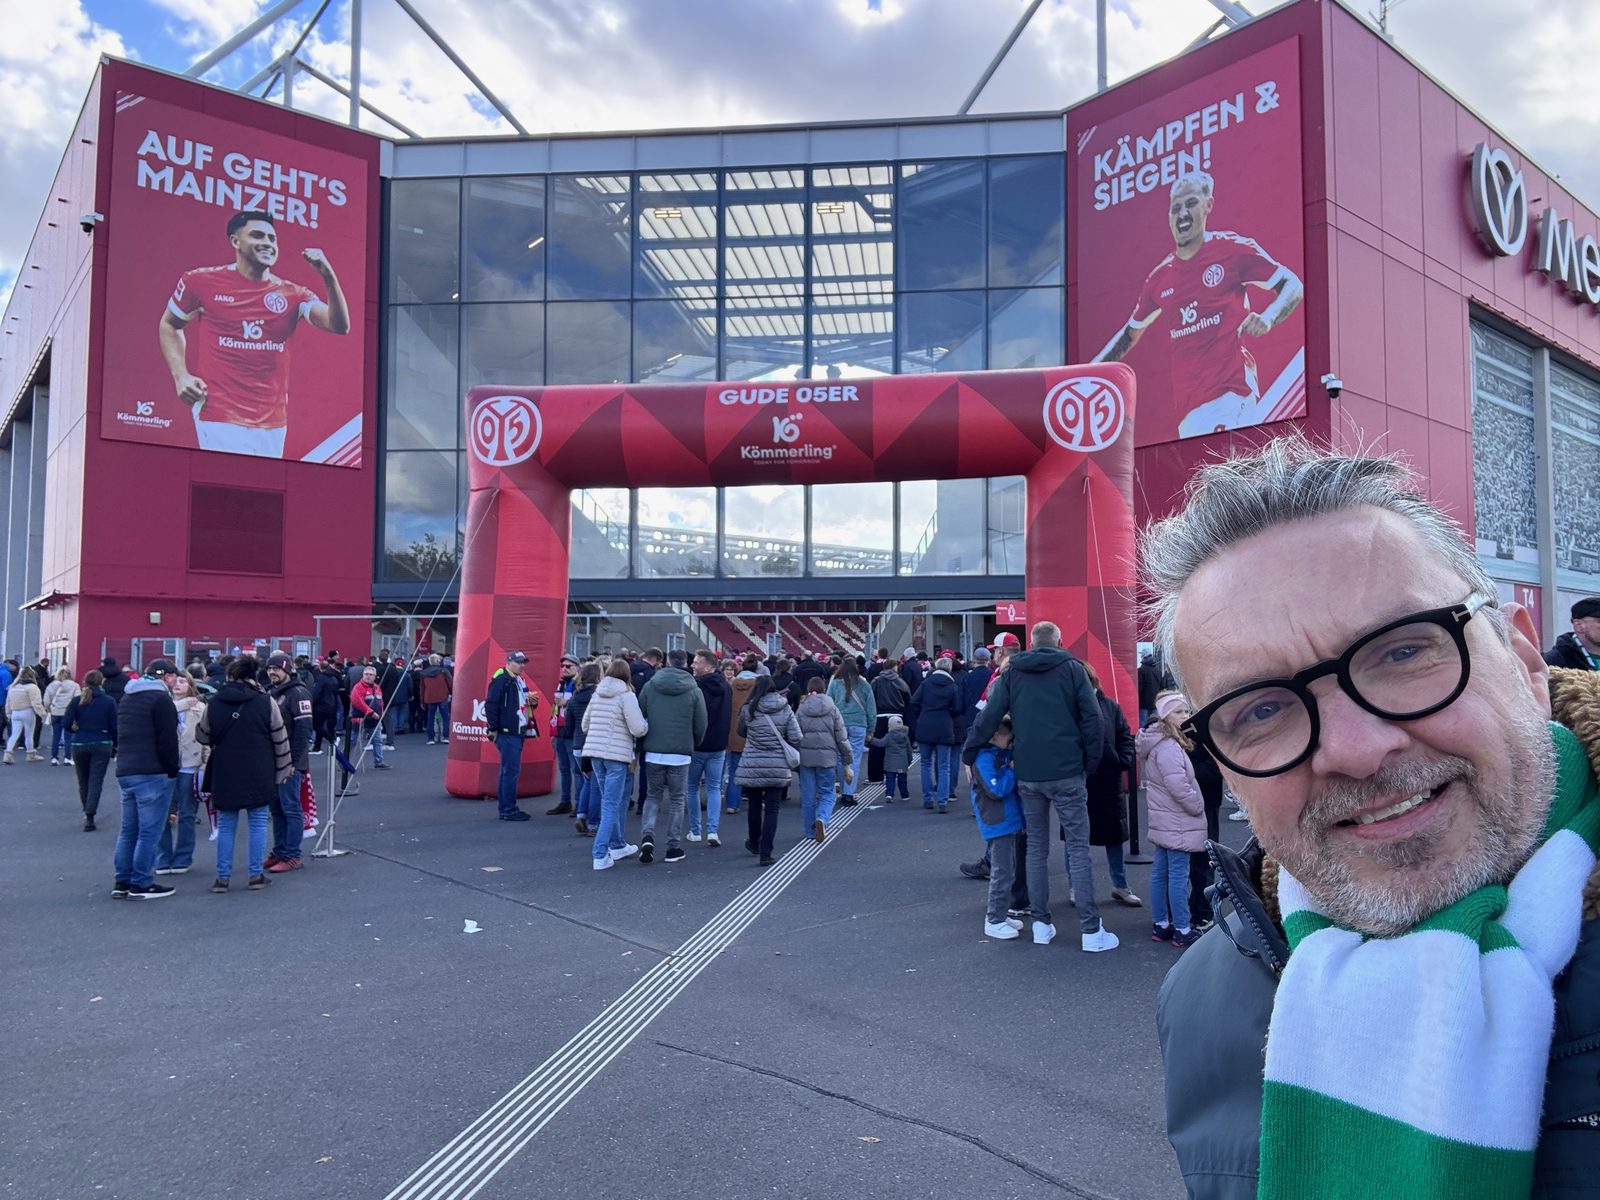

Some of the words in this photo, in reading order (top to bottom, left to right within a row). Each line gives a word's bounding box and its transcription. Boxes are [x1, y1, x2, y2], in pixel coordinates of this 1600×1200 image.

[1094, 92, 1245, 182] KÄMPFEN
[1254, 80, 1280, 114] &
[137, 129, 214, 171] AUF
[1093, 139, 1212, 211] SIEGEN!
[136, 159, 319, 230] MAINZER!
[214, 294, 235, 303] JAKO
[218, 335, 285, 353] Kömmerling
[718, 387, 789, 406] GUDE
[116, 411, 171, 428] Kömmerling
[740, 443, 834, 460] Kömmerling
[1522, 588, 1535, 609] T4
